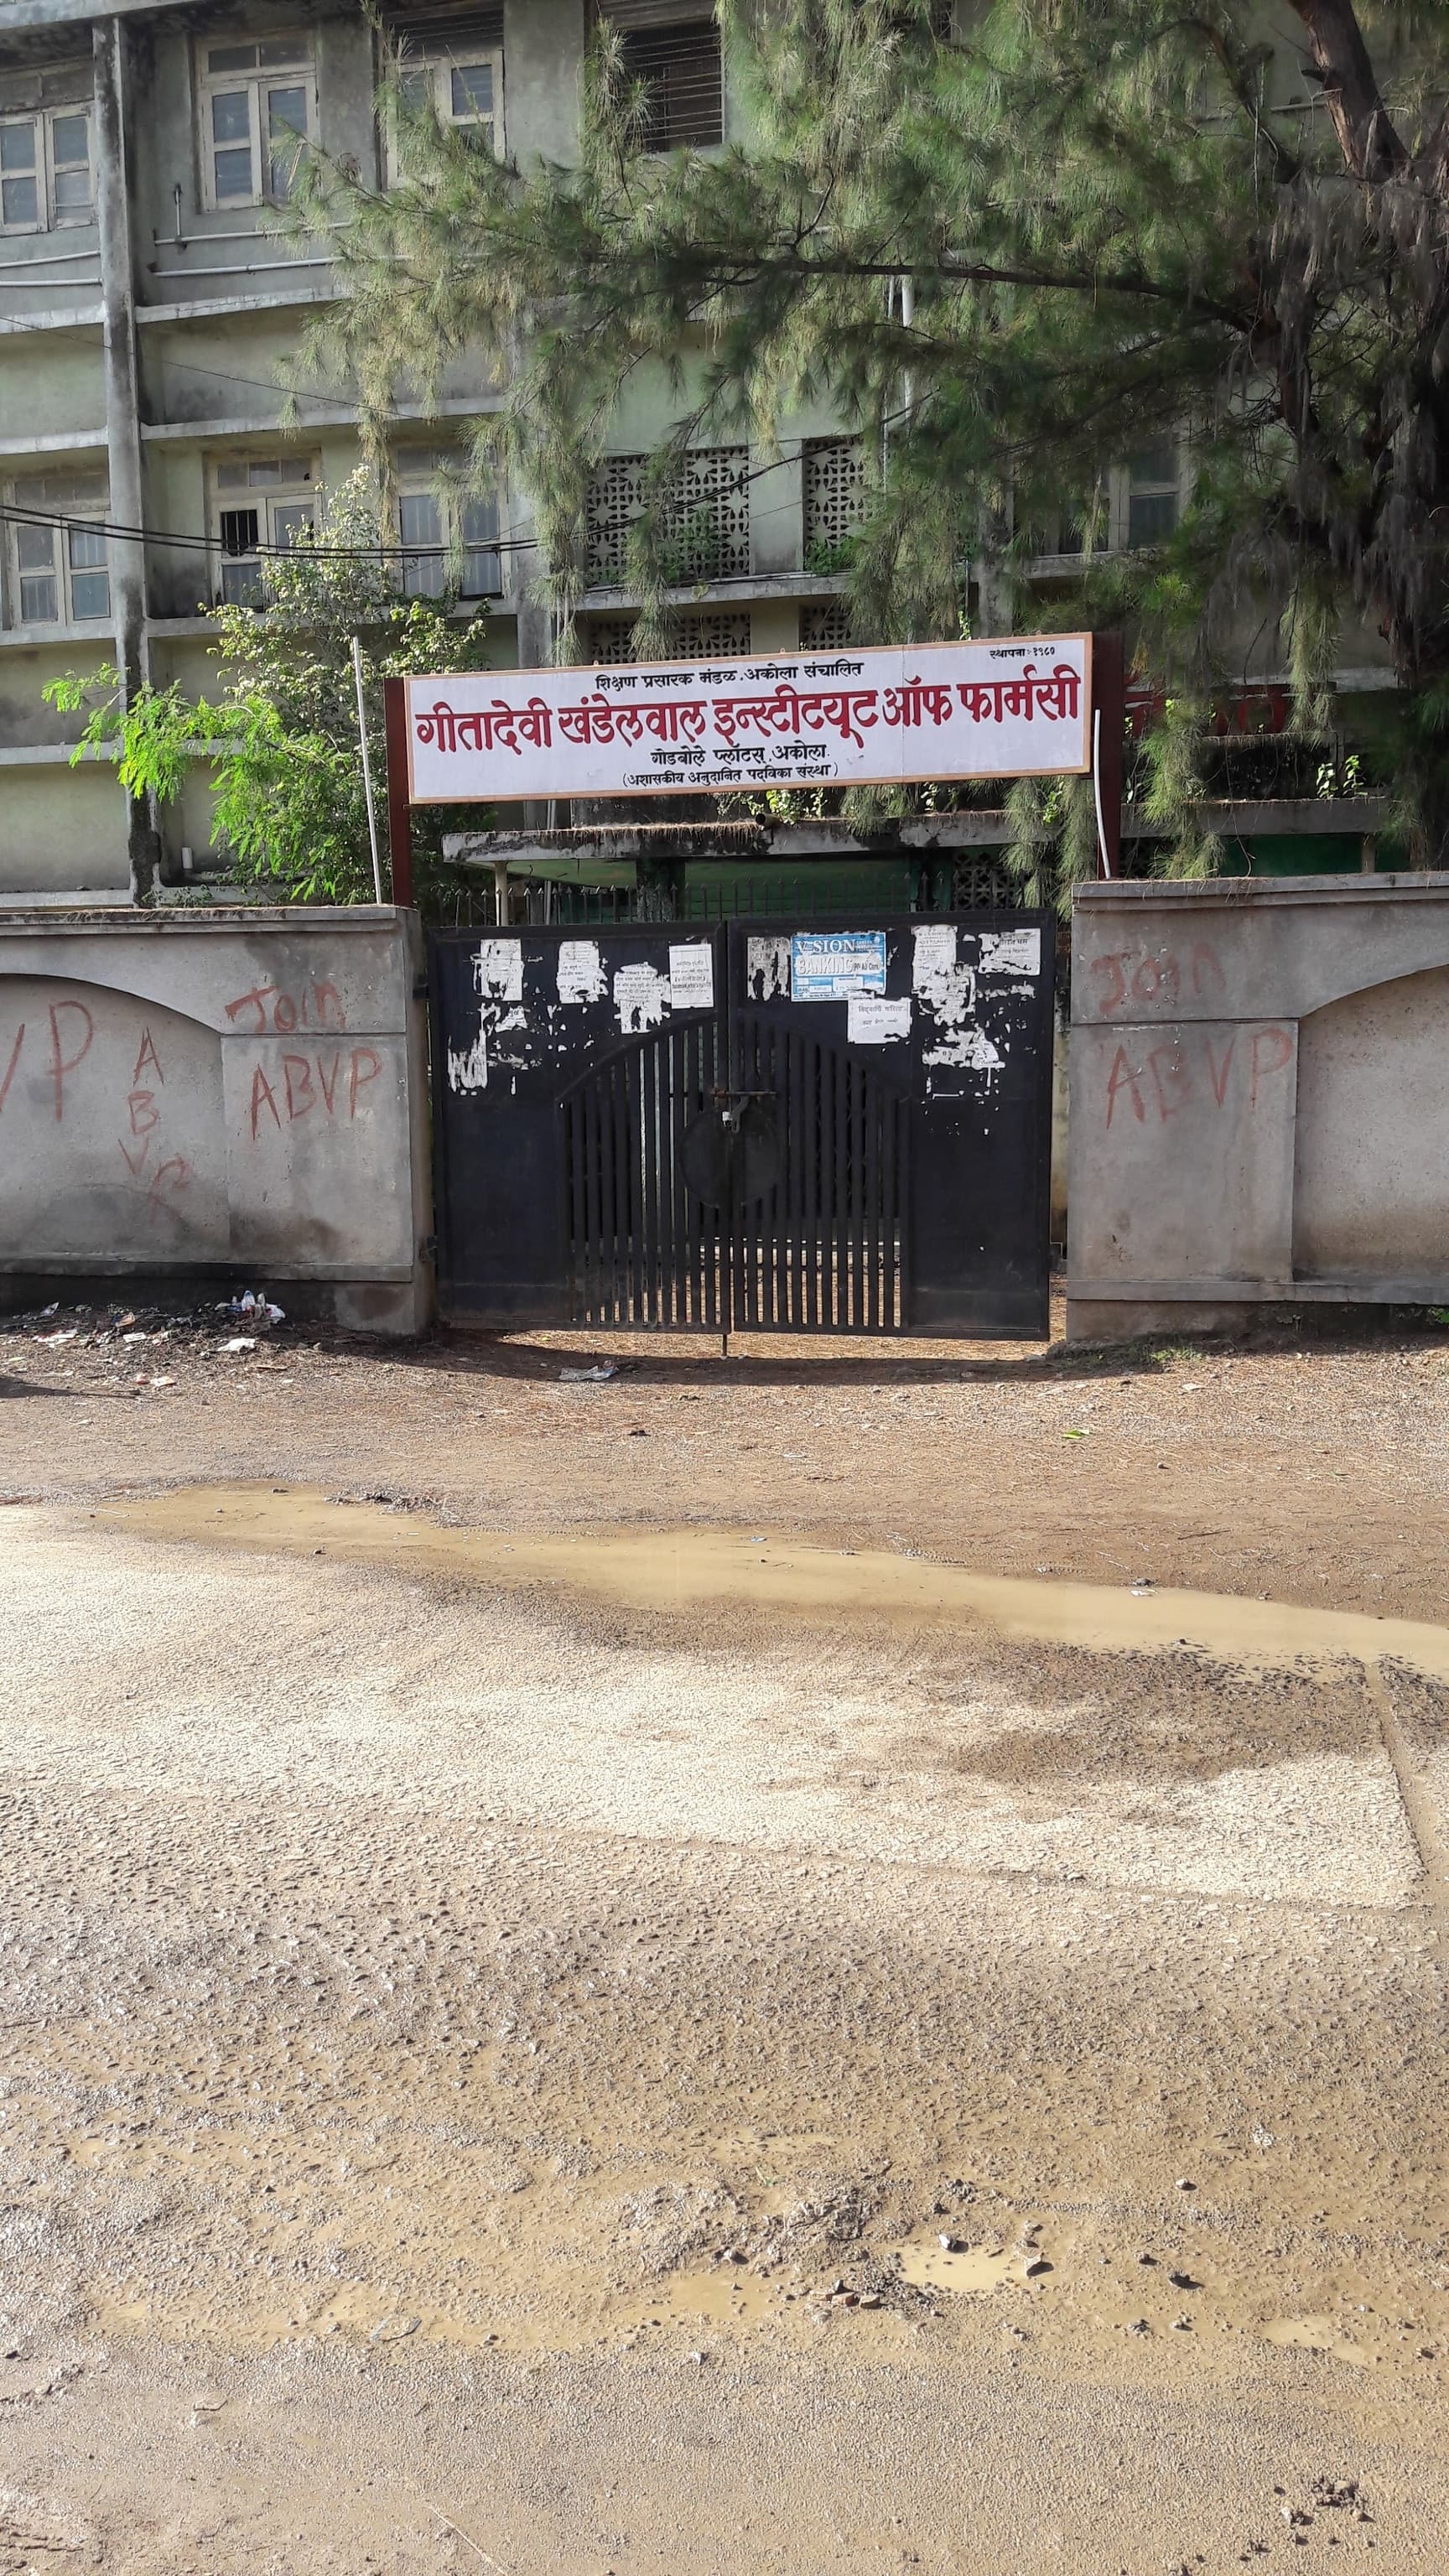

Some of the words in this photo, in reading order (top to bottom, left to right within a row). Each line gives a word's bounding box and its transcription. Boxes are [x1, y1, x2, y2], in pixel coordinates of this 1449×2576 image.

[595, 674, 637, 692] शिक्षण
[641, 673, 694, 688] प्रसारक
[804, 658, 865, 678] संचालित
[415, 698, 553, 755] गीतादेवी
[558, 693, 707, 746] खंडेलवाल
[882, 675, 953, 727] ऑफ
[956, 664, 1081, 724] फार्मसी
[651, 745, 706, 766] गोडबोले
[688, 766, 743, 786] अनुदानित
[252, 1047, 382, 1140] ABVP
[1107, 1028, 1293, 1130] ABVP
